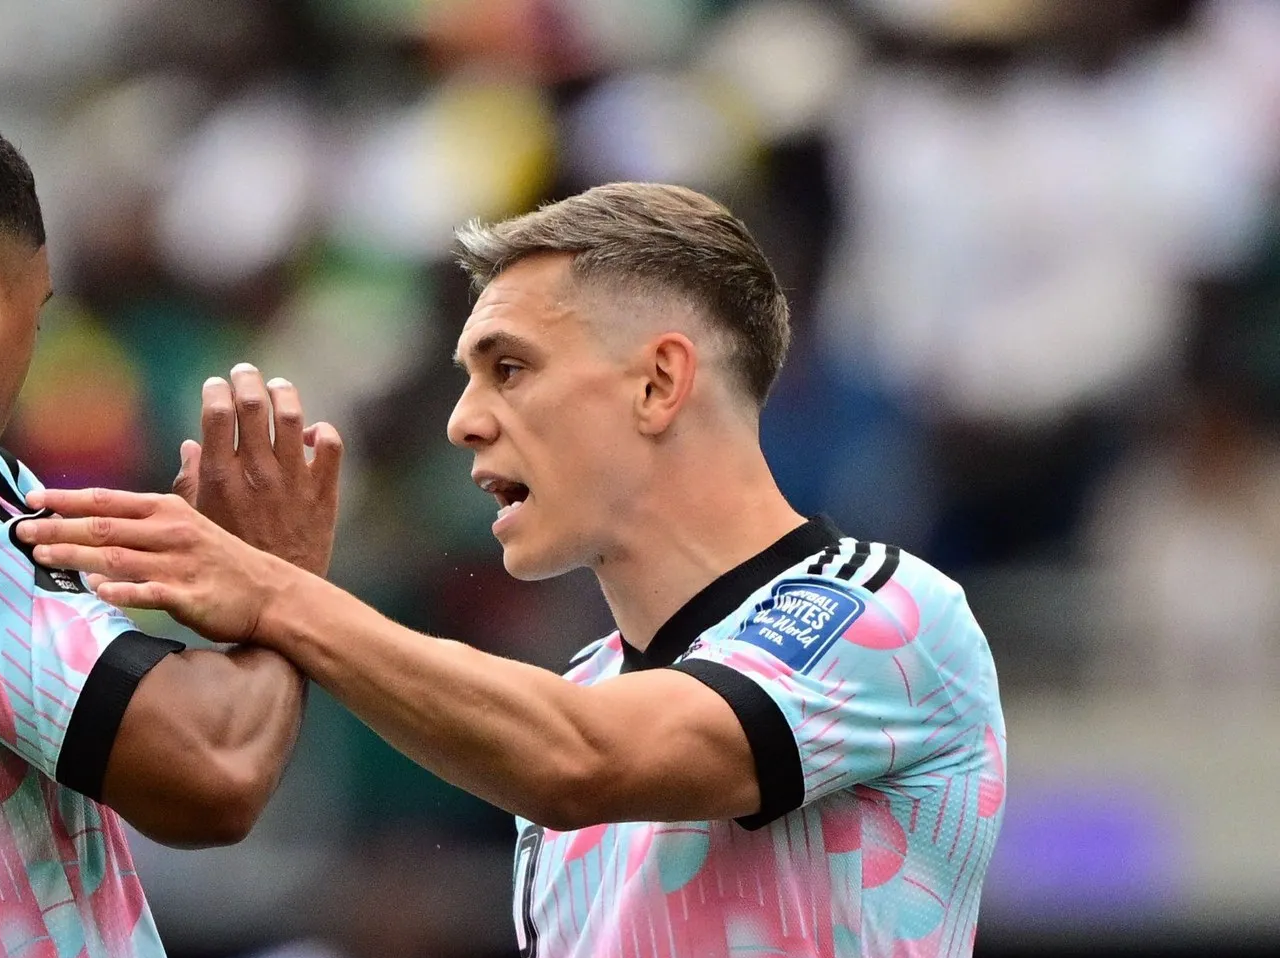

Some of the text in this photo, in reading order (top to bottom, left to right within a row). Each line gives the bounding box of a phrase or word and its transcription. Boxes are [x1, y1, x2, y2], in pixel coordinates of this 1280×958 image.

[773, 594, 831, 630] UNITES
[758, 626, 783, 646] FIFA
[772, 614, 820, 649] World
